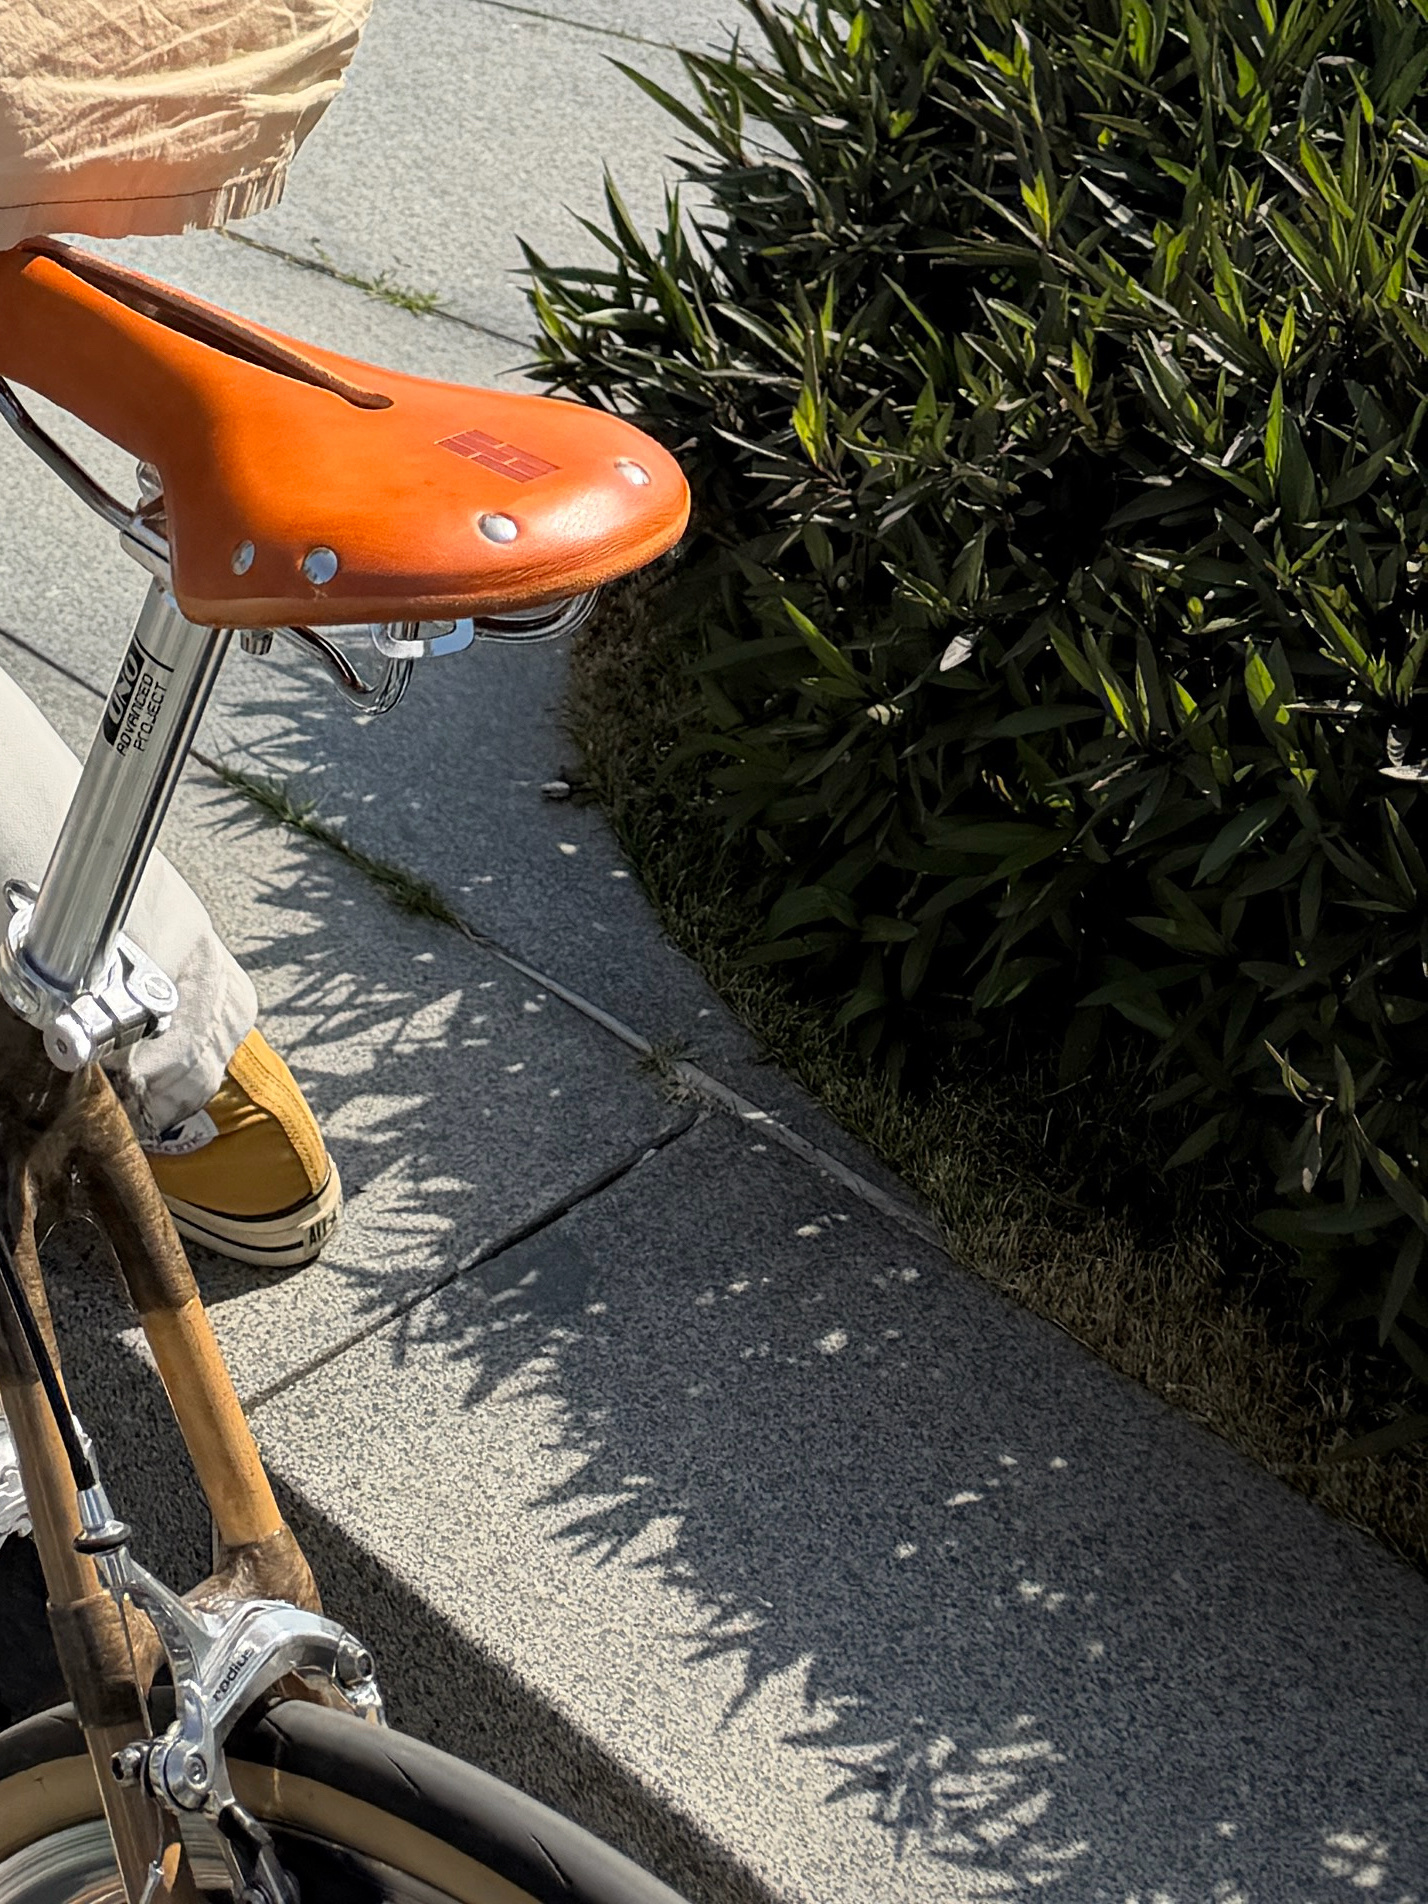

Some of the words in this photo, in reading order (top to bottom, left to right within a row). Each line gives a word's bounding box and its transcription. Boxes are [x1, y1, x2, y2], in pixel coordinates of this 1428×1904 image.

[116, 672, 154, 757] ADVANCED
[133, 681, 168, 753] PROJECT
[213, 1647, 255, 1702] radius
